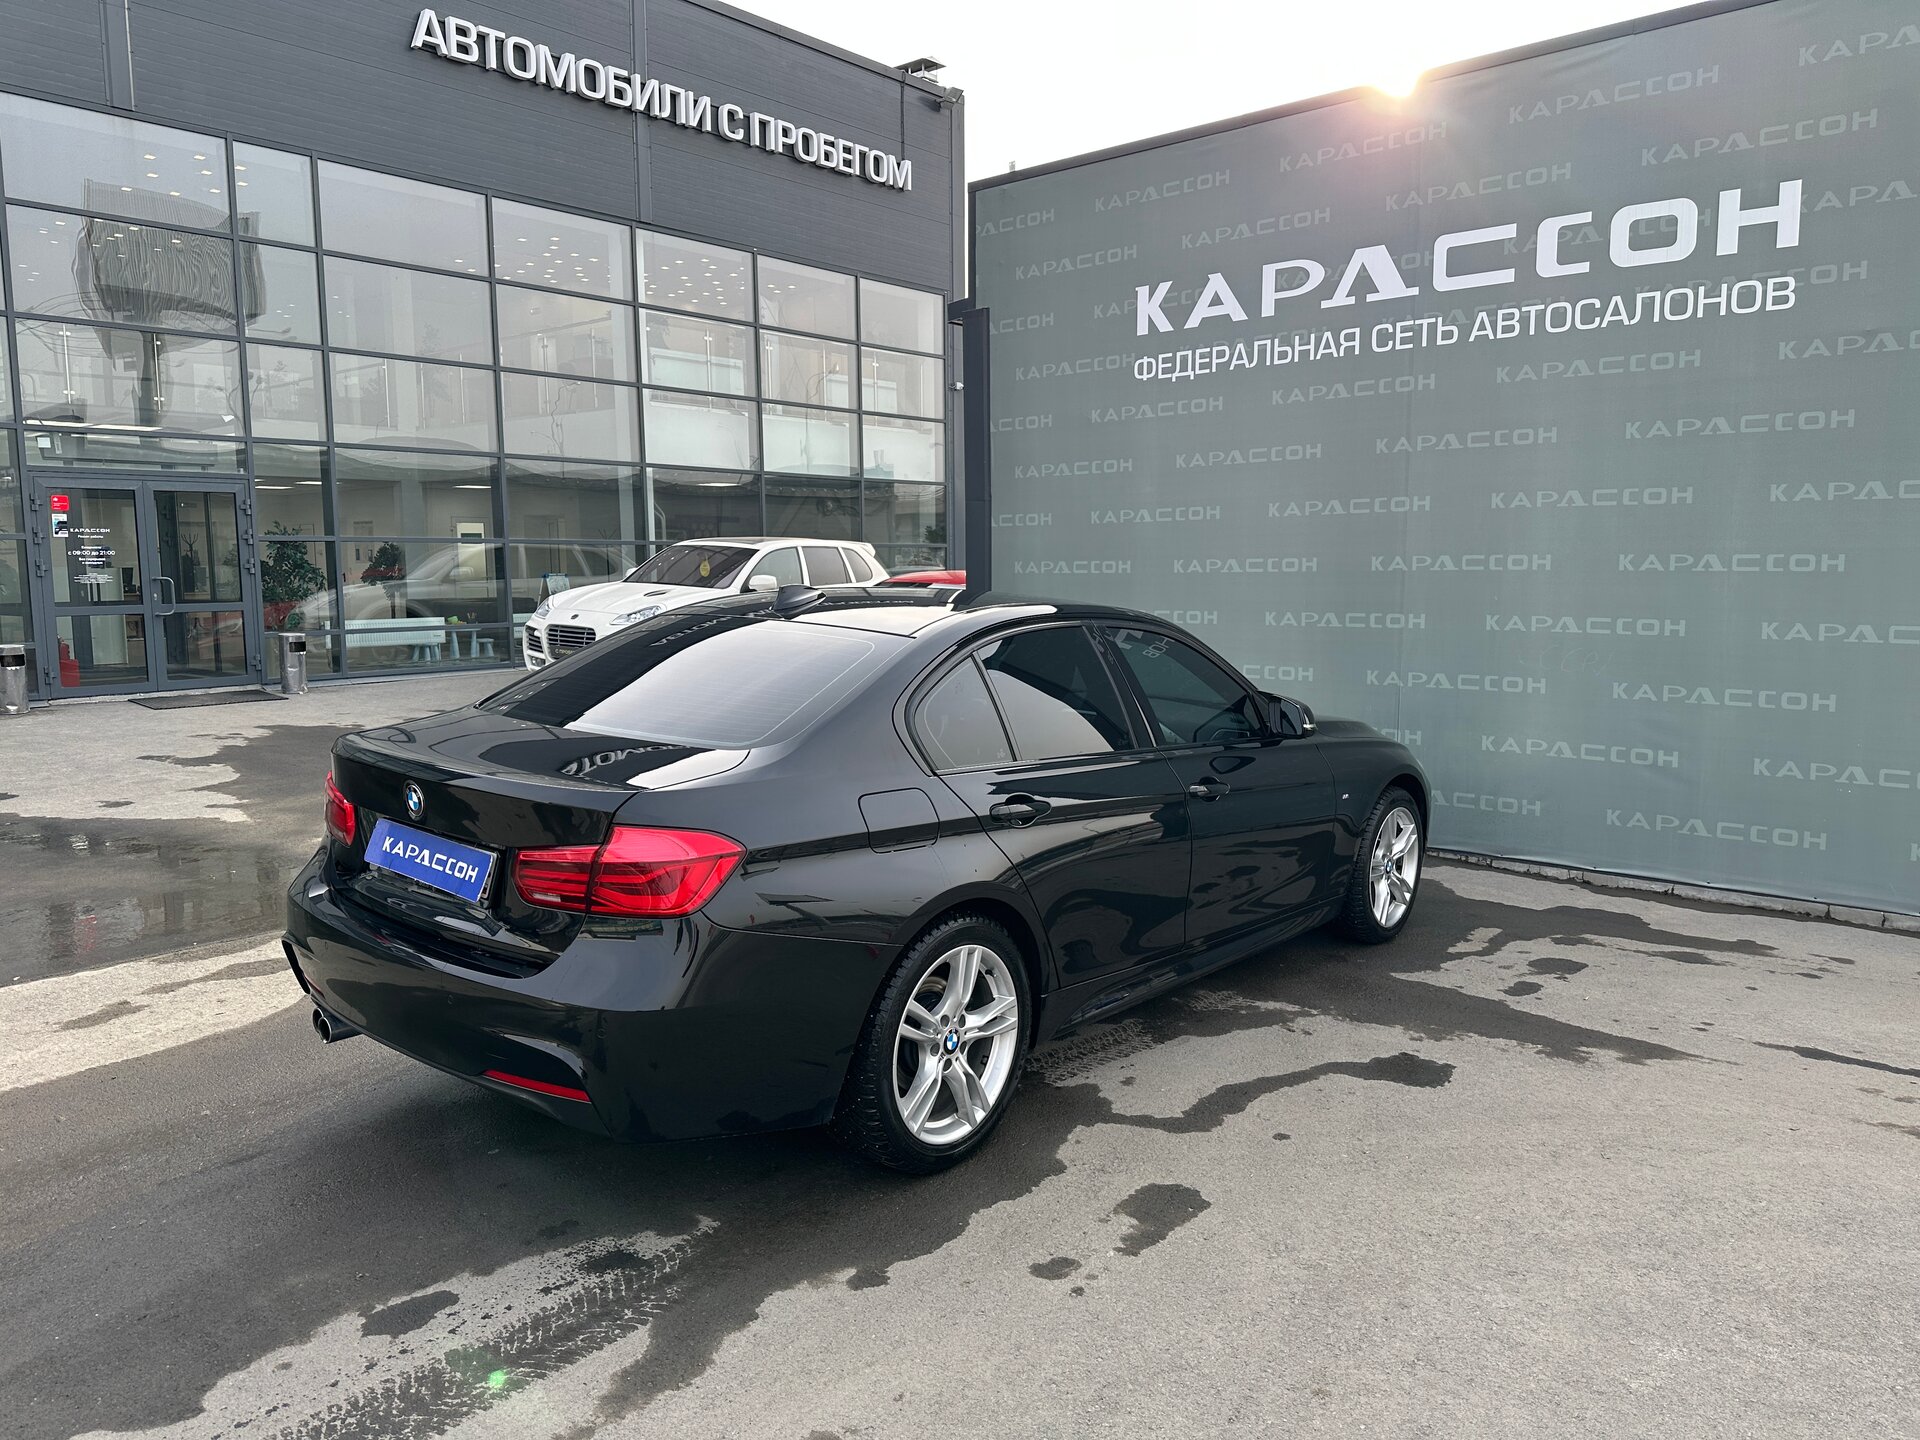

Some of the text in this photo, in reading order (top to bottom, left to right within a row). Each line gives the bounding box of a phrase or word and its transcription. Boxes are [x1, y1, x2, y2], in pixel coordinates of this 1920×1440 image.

[411, 9, 912, 191] АВТОМОБИЛИ С ПРОБЕГОМ
[1508, 63, 1720, 124] КАРАССОН
[1278, 121, 1447, 172] КАРАССОН
[1641, 108, 1878, 166] КАРАССОН
[1094, 169, 1231, 213] КАРАССОН
[1385, 160, 1572, 212] КАРАССОН
[1181, 207, 1331, 250] КАРАССОН
[1015, 244, 1138, 281] КАРАССОН
[1136, 179, 1802, 336] КАРАССОН
[1133, 276, 1796, 382] ФЕДЕРАЛЬНАЯ СЕТЬ АВТОСАЛОНОВ
[1015, 352, 1136, 381] КАРАССОН
[1496, 349, 1701, 384] КАРАССОН
[1272, 372, 1436, 405] КАРАССОН
[1091, 395, 1223, 424] КАРАССОН
[1625, 408, 1856, 440] КАРАССОН
[1376, 426, 1558, 454] КАРАССОН
[1014, 457, 1133, 479] КАРАССОН
[1175, 443, 1323, 470] КАРАССОН
[1267, 495, 1431, 519] КАРАССОН
[1490, 486, 1694, 510] КАРАССОН
[1090, 505, 1222, 525] КАРАССОН
[1014, 560, 1132, 575] КАРАССОН
[1172, 556, 1319, 575] КАРАССОН
[1371, 554, 1552, 572] КАРАССОН
[1617, 553, 1847, 573] КАРАССОН
[1265, 610, 1426, 630] КАРАССОН
[1485, 613, 1687, 638] КАРАССОН
[1366, 669, 1547, 695] КАРАССОН
[1611, 681, 1837, 713] КАРАССОН
[1480, 734, 1680, 769] КАРАССОН
[1605, 807, 1828, 851] КАРАССОН
[382, 836, 479, 883] КАРАССОН
